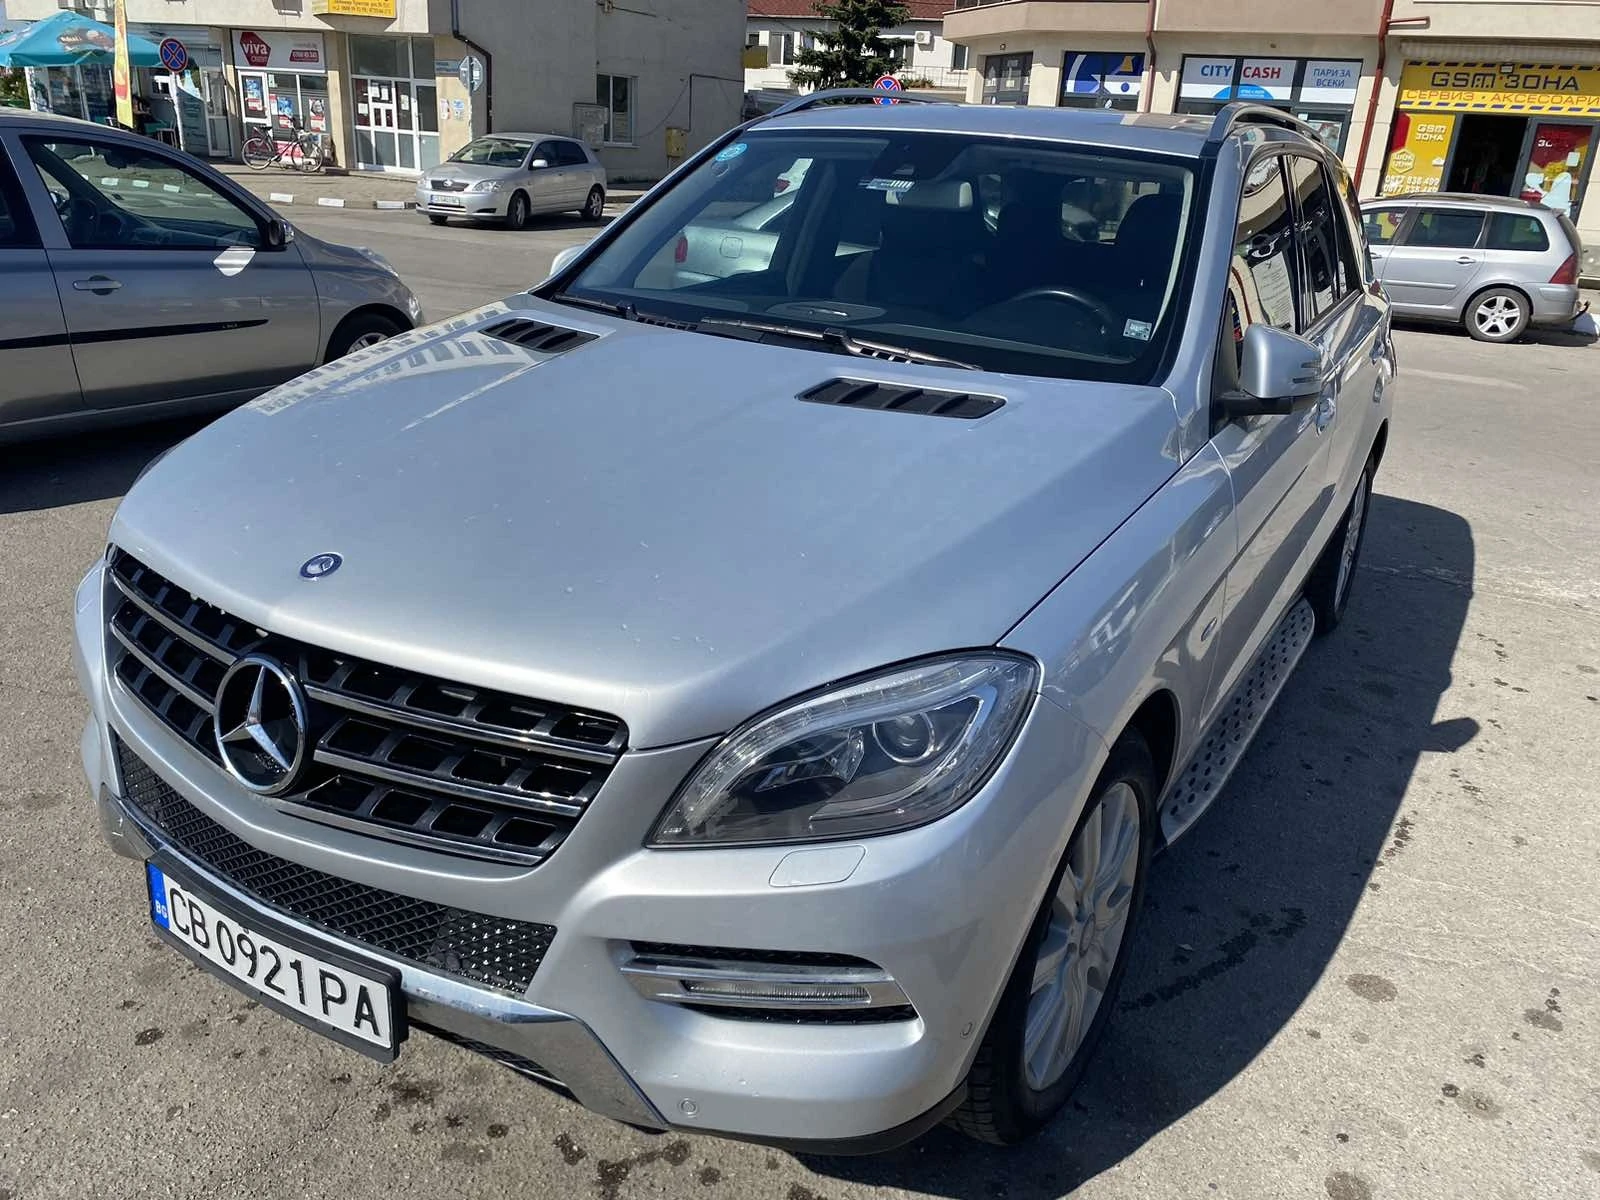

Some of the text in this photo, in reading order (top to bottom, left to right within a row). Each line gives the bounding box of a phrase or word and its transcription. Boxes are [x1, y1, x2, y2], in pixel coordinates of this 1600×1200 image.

[242, 41, 269, 55] viva
[1200, 64, 1282, 79] CITY CASH
[1316, 78, 1345, 88] ВСЕКИ
[1431, 71, 1579, 91] GSM ЗОНА
[1406, 89, 1600, 105] СЕРВИЗ АКСЕСОАРИ
[1417, 124, 1447, 133] GSM
[155, 899, 168, 919] BG
